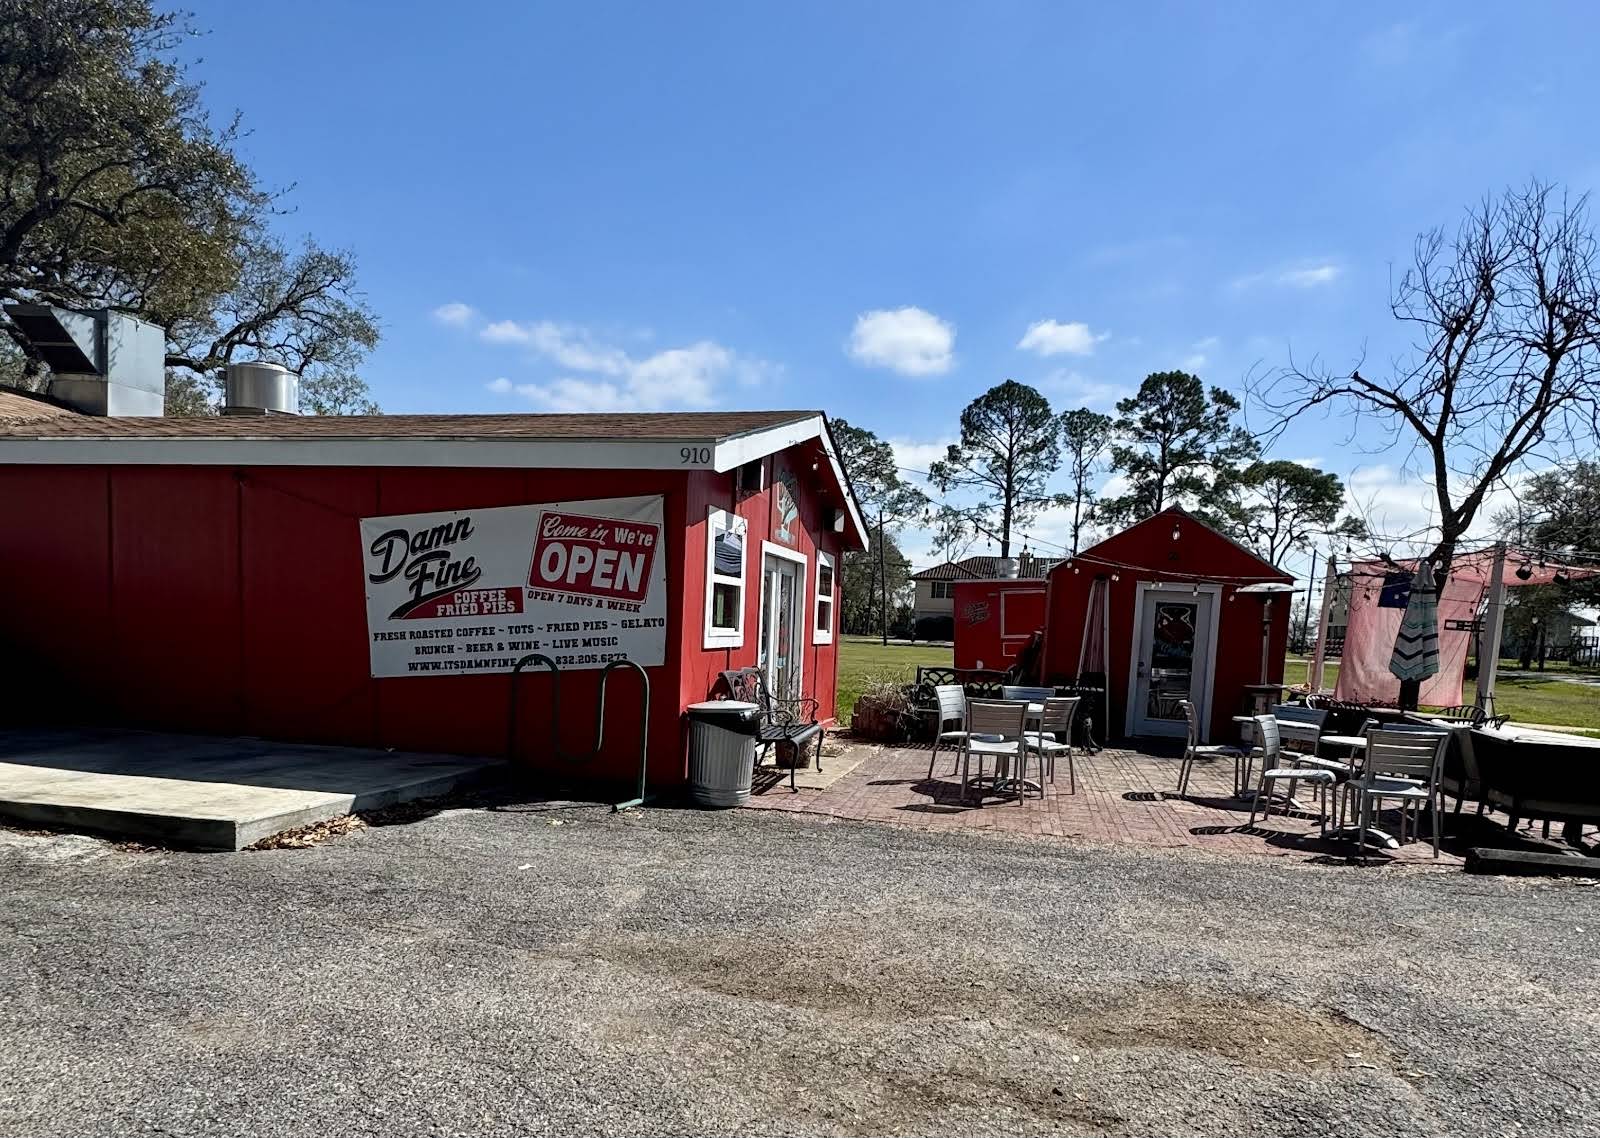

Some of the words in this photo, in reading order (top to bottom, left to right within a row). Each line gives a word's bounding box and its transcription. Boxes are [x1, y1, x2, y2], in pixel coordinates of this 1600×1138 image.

[680, 447, 711, 464] 910
[543, 516, 588, 539] Come
[590, 523, 609, 544] in
[614, 527, 654, 547] We're
[368, 517, 475, 584] Damn
[539, 541, 646, 593] OPEN
[392, 550, 482, 614] Fine
[454, 590, 507, 604] COFFEE
[527, 590, 555, 602] OPEN
[558, 594, 564, 603] 7
[566, 595, 593, 607] DAYS
[595, 599, 604, 609] A
[607, 601, 642, 613] WEEK
[436, 603, 478, 617] FRIED
[482, 601, 516, 614] PIES
[373, 632, 407, 641] FRESH
[409, 629, 453, 640] ROASTED
[456, 626, 496, 637] COFFEE
[507, 624, 535, 634] TOTS
[546, 622, 580, 633] FRIED
[583, 620, 608, 631] PIES
[621, 617, 665, 629] GELATO
[414, 645, 455, 655] BRUNCH
[466, 643, 494, 653] BEER
[497, 642, 505, 651] &
[508, 640, 540, 651] WINE
[552, 638, 579, 649] LIVE
[582, 636, 619, 648] MUSIC
[408, 657, 543, 671] WWW.ITSDAMNFINEOM
[555, 653, 628, 665] 832.205.6273
